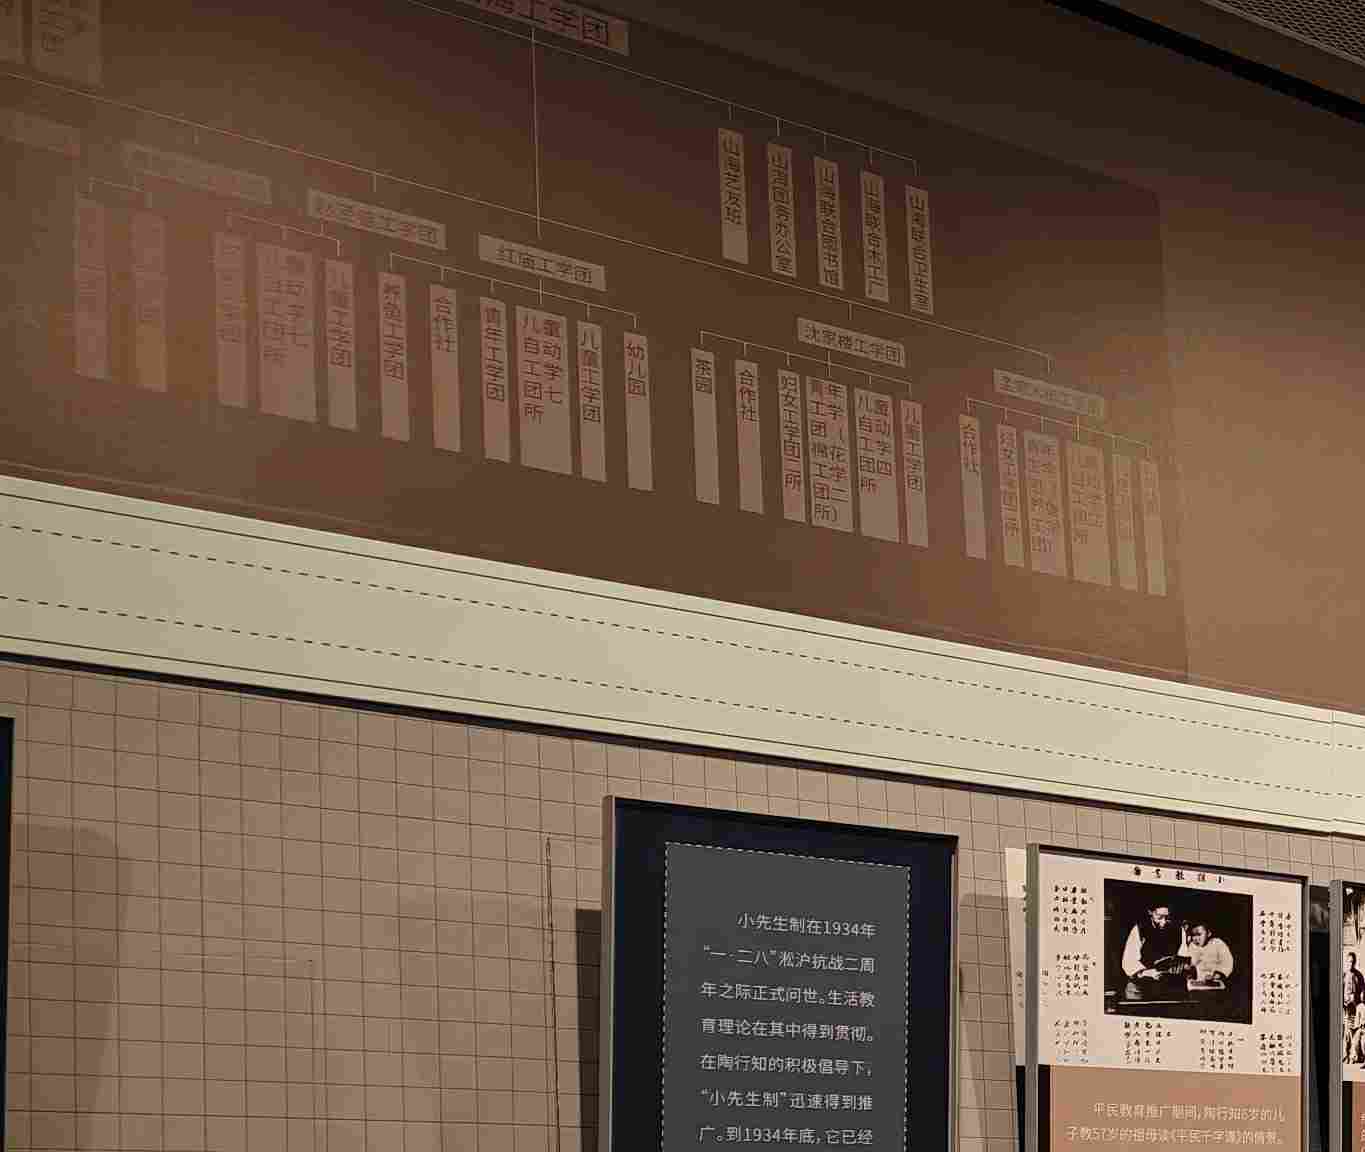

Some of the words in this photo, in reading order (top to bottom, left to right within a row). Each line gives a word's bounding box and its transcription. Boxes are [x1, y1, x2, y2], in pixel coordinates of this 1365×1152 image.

[736, 911, 877, 937] 小先生制在1934年
[700, 982, 876, 1008] 年之际正式问世。生活教
[700, 1017, 875, 1043] 育理论在其中得到贯彻。
